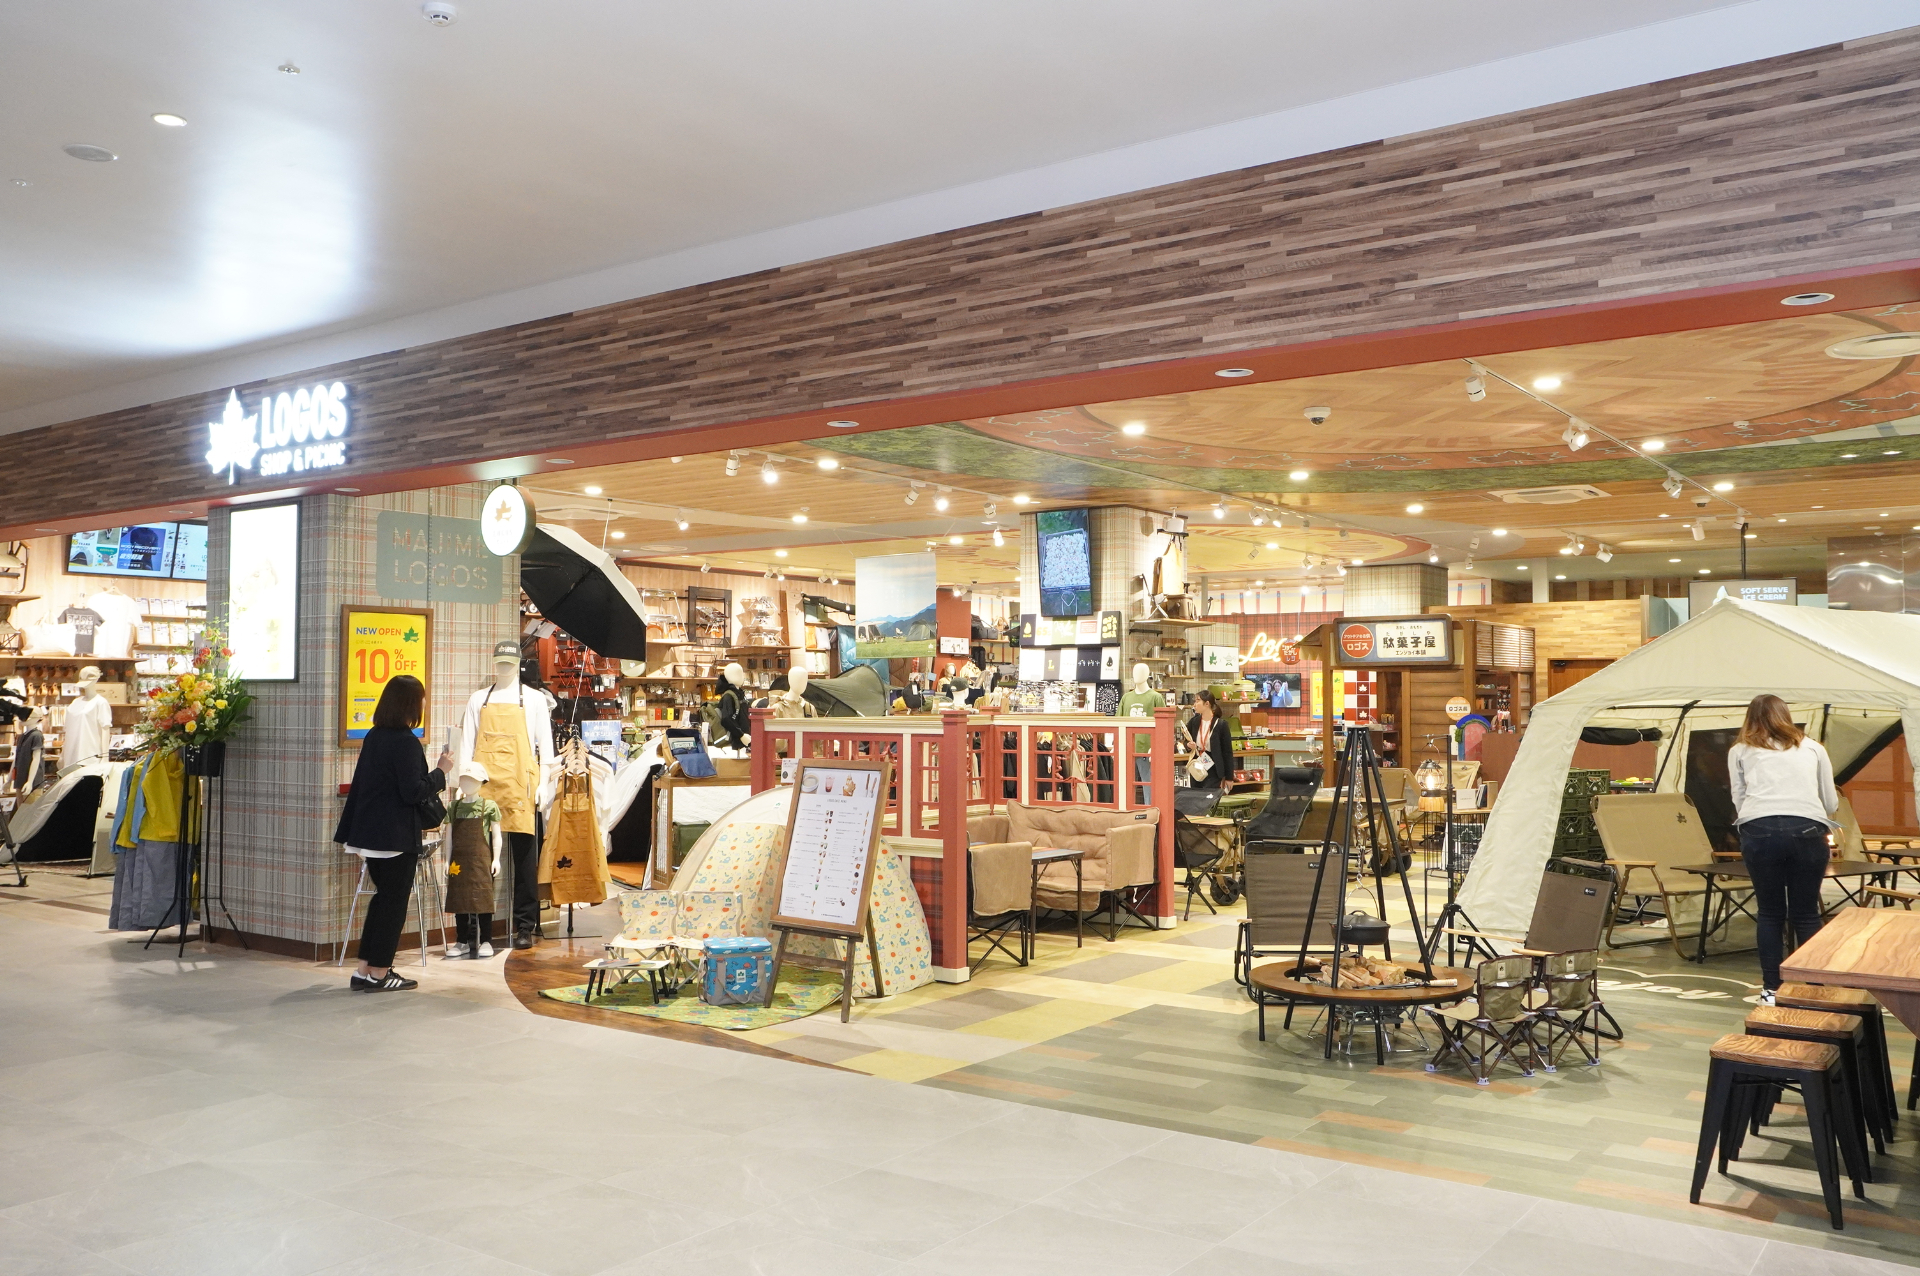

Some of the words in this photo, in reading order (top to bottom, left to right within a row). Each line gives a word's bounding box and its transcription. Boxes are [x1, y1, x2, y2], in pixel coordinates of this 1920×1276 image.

[261, 381, 347, 449] LOGOS
[260, 450, 292, 476] SHOP
[304, 441, 345, 470] PICNIC
[392, 526, 489, 559] MAJIME
[394, 559, 488, 590] LOGOS
[1740, 587, 1761, 595] SOFT
[1762, 586, 1789, 594] SERVE
[1757, 593, 1787, 601] CREAM
[356, 627, 378, 635] NEW
[378, 628, 401, 636] OPEN
[1347, 641, 1370, 651] ロゴス
[1382, 635, 1436, 649] 駄菓子屋
[355, 648, 390, 684] 10
[394, 648, 404, 660] %
[394, 660, 418, 671] OFF
